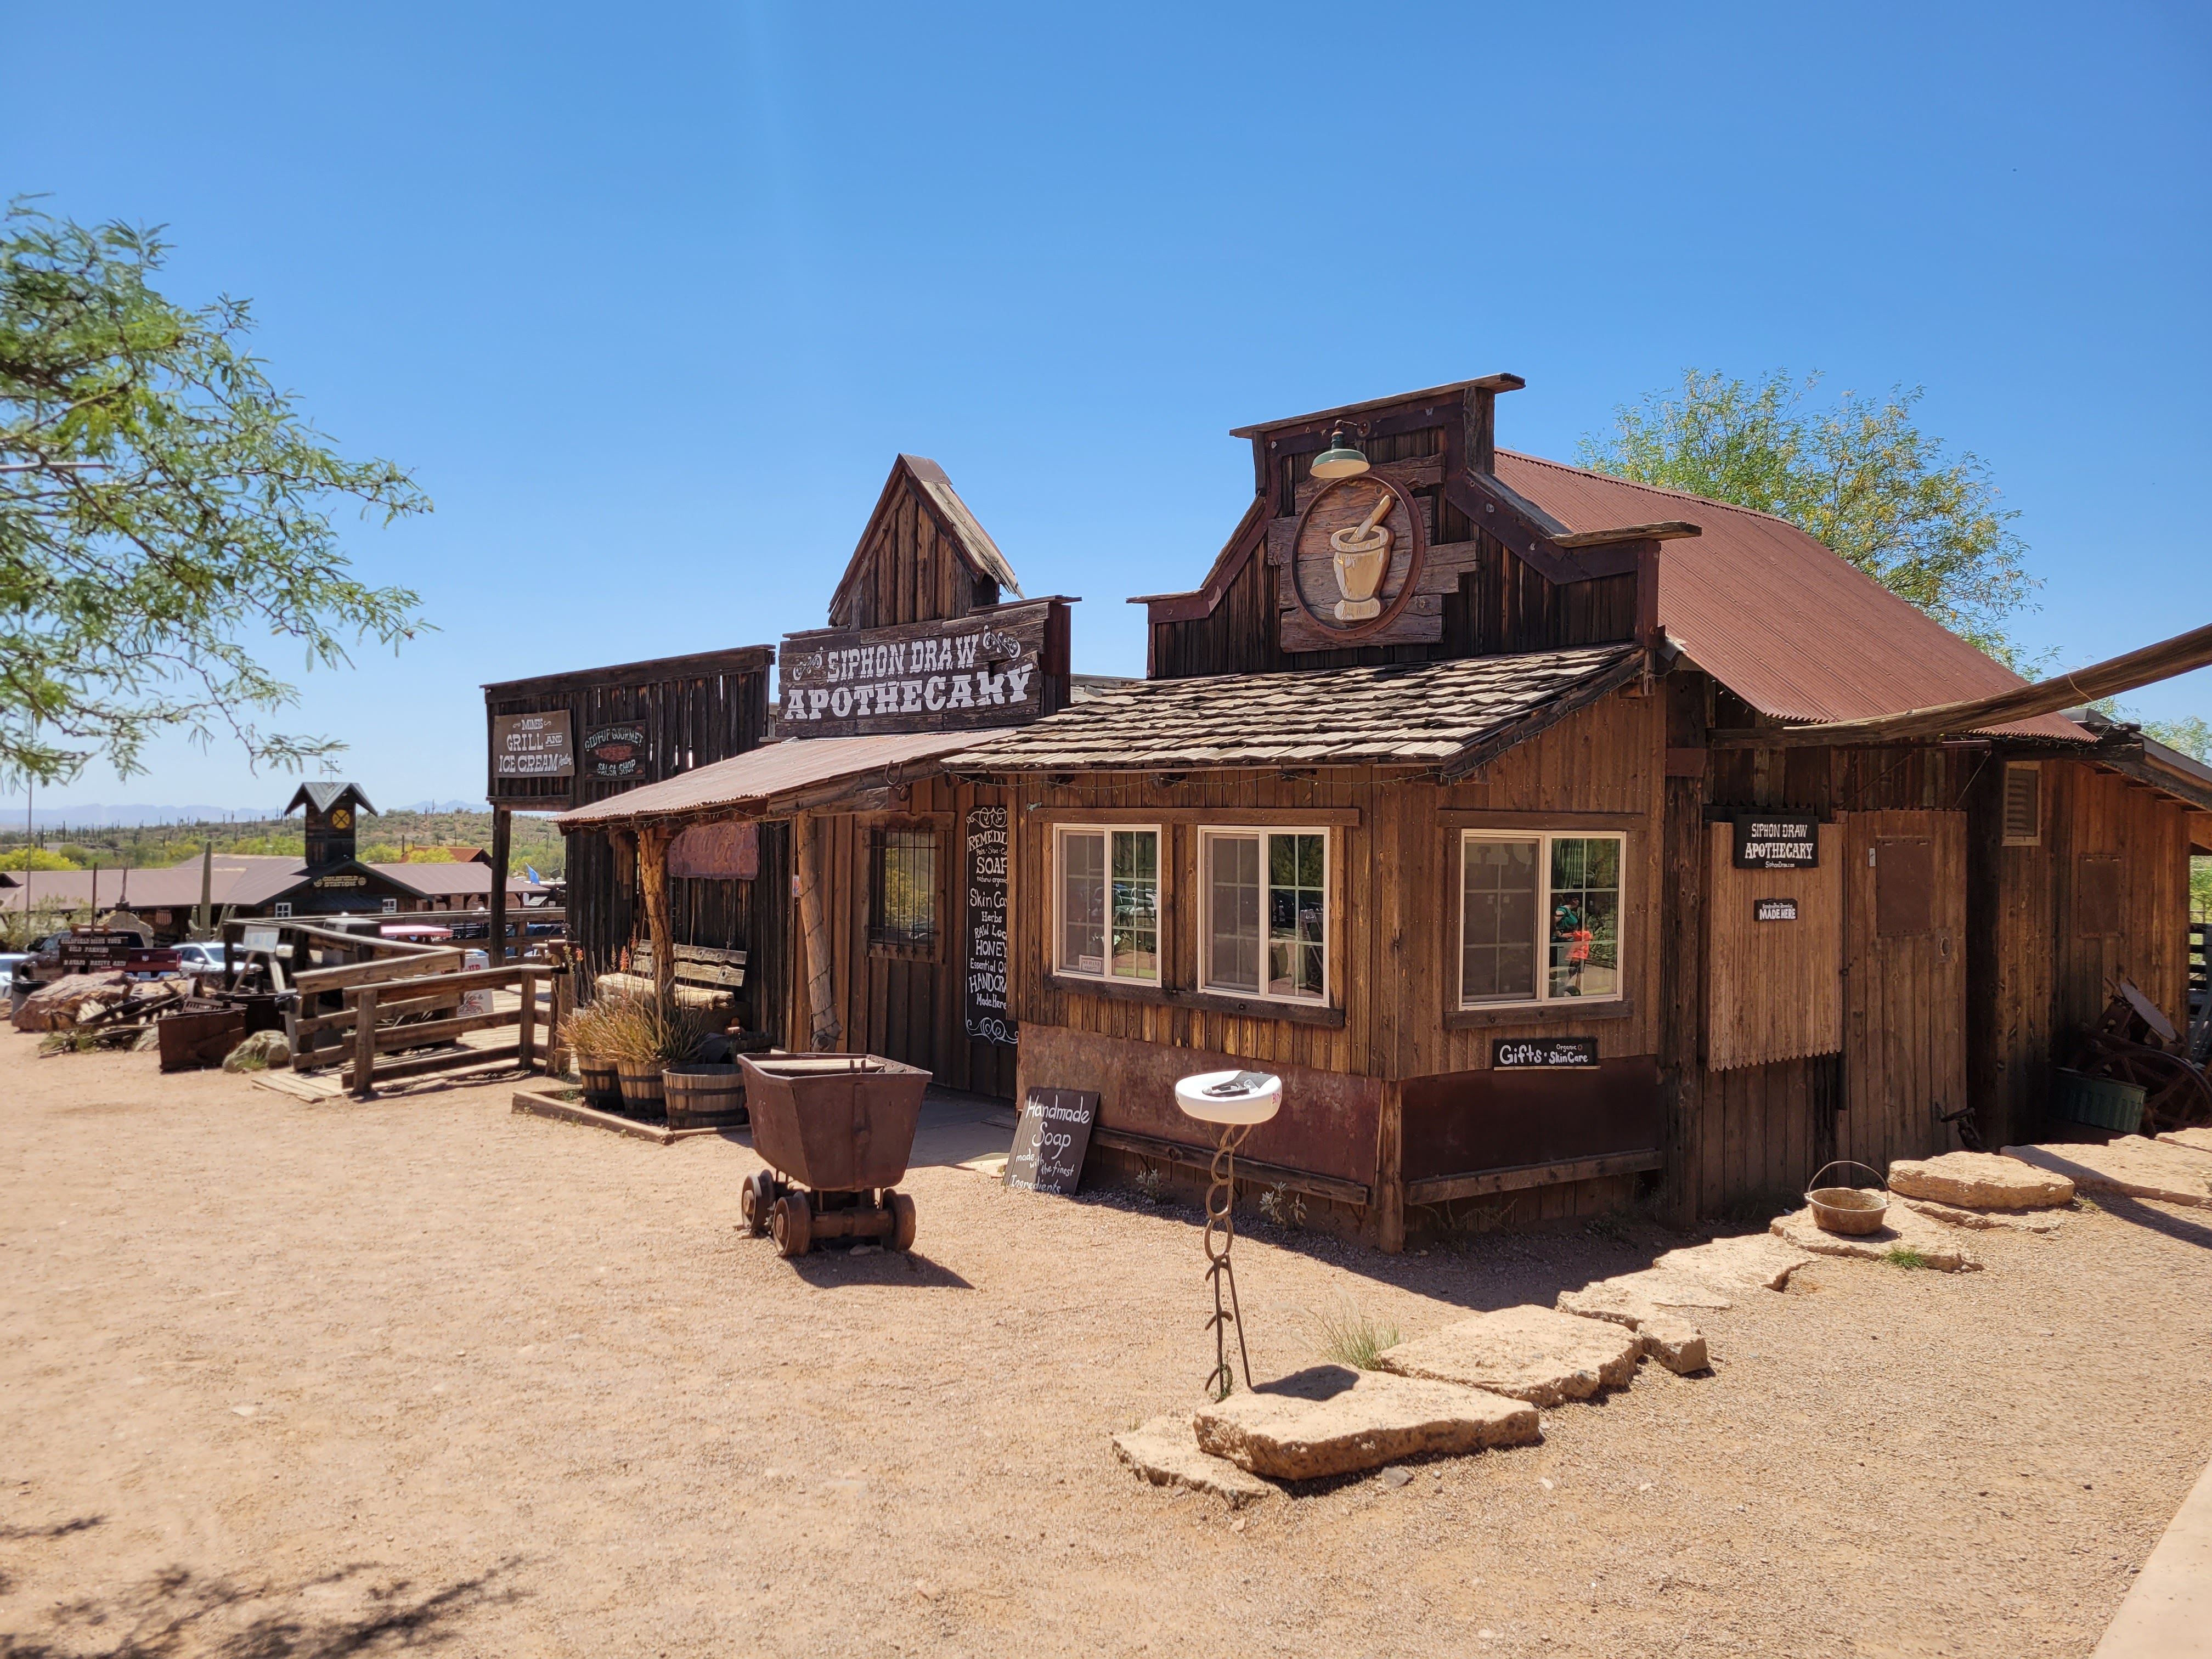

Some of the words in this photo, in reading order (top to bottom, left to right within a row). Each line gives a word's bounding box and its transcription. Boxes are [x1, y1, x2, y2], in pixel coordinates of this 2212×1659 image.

[826, 641, 906, 682] SIPHON
[910, 634, 979, 673] DRAW
[784, 663, 1034, 720] APOTHECARY
[506, 733, 544, 752] GRILL
[545, 735, 562, 744] AND
[499, 754, 516, 773] ICE
[517, 753, 558, 772] CREAM
[619, 759, 636, 775] SHOP
[1751, 823, 1780, 838] SIPHON
[1782, 824, 1808, 838] DRAW
[968, 830, 1007, 852] REMEDI
[1745, 843, 1813, 859] APOTHECARY
[976, 856, 1008, 874] SOAP
[970, 888, 992, 908] Skin
[994, 891, 1007, 908] Ca
[981, 911, 1002, 923] Herbs
[1759, 909, 1780, 920] MADE
[1781, 909, 1796, 919] HERE
[974, 924, 989, 939] RAW
[992, 924, 1007, 940] Loc
[976, 940, 1007, 958] HONEY
[970, 958, 996, 973] Essential
[969, 973, 1007, 994] HANDCR
[977, 993, 992, 1007] Made
[992, 993, 1007, 1009] Here
[1499, 1045, 1542, 1064] Gifts
[1556, 1044, 1577, 1052] Organic
[1025, 1094, 1090, 1124] Handmade
[1032, 1121, 1071, 1159] Soap
[1016, 1148, 1035, 1162] made
[1030, 1153, 1045, 1168] with
[1041, 1164, 1052, 1175] the
[1052, 1160, 1075, 1177] finest
[1010, 1175, 1061, 1194] Ingredients
